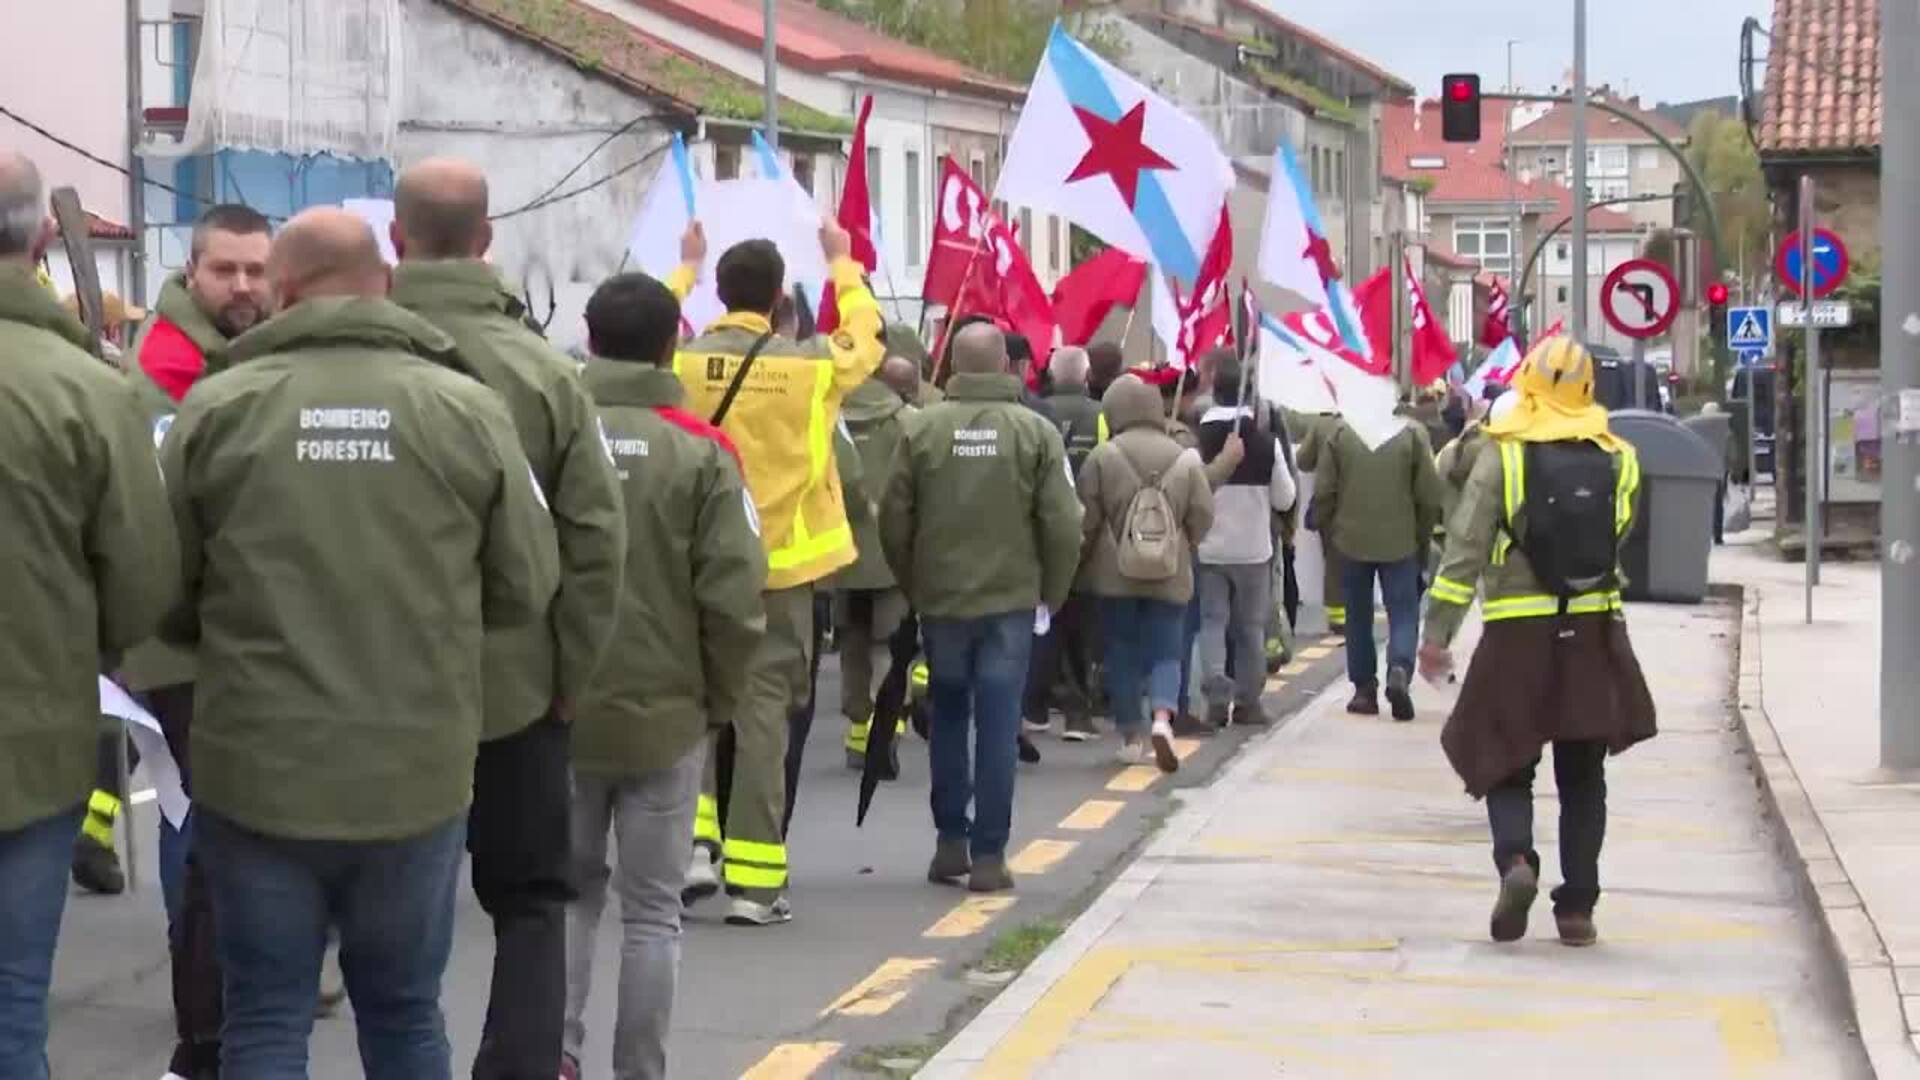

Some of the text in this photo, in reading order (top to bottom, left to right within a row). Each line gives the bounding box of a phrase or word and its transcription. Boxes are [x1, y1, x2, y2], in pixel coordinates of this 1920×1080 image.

[300, 409, 391, 430] BOMBEIRO
[296, 440, 395, 461] FORESTAL
[952, 445, 997, 457] FORESTAL
